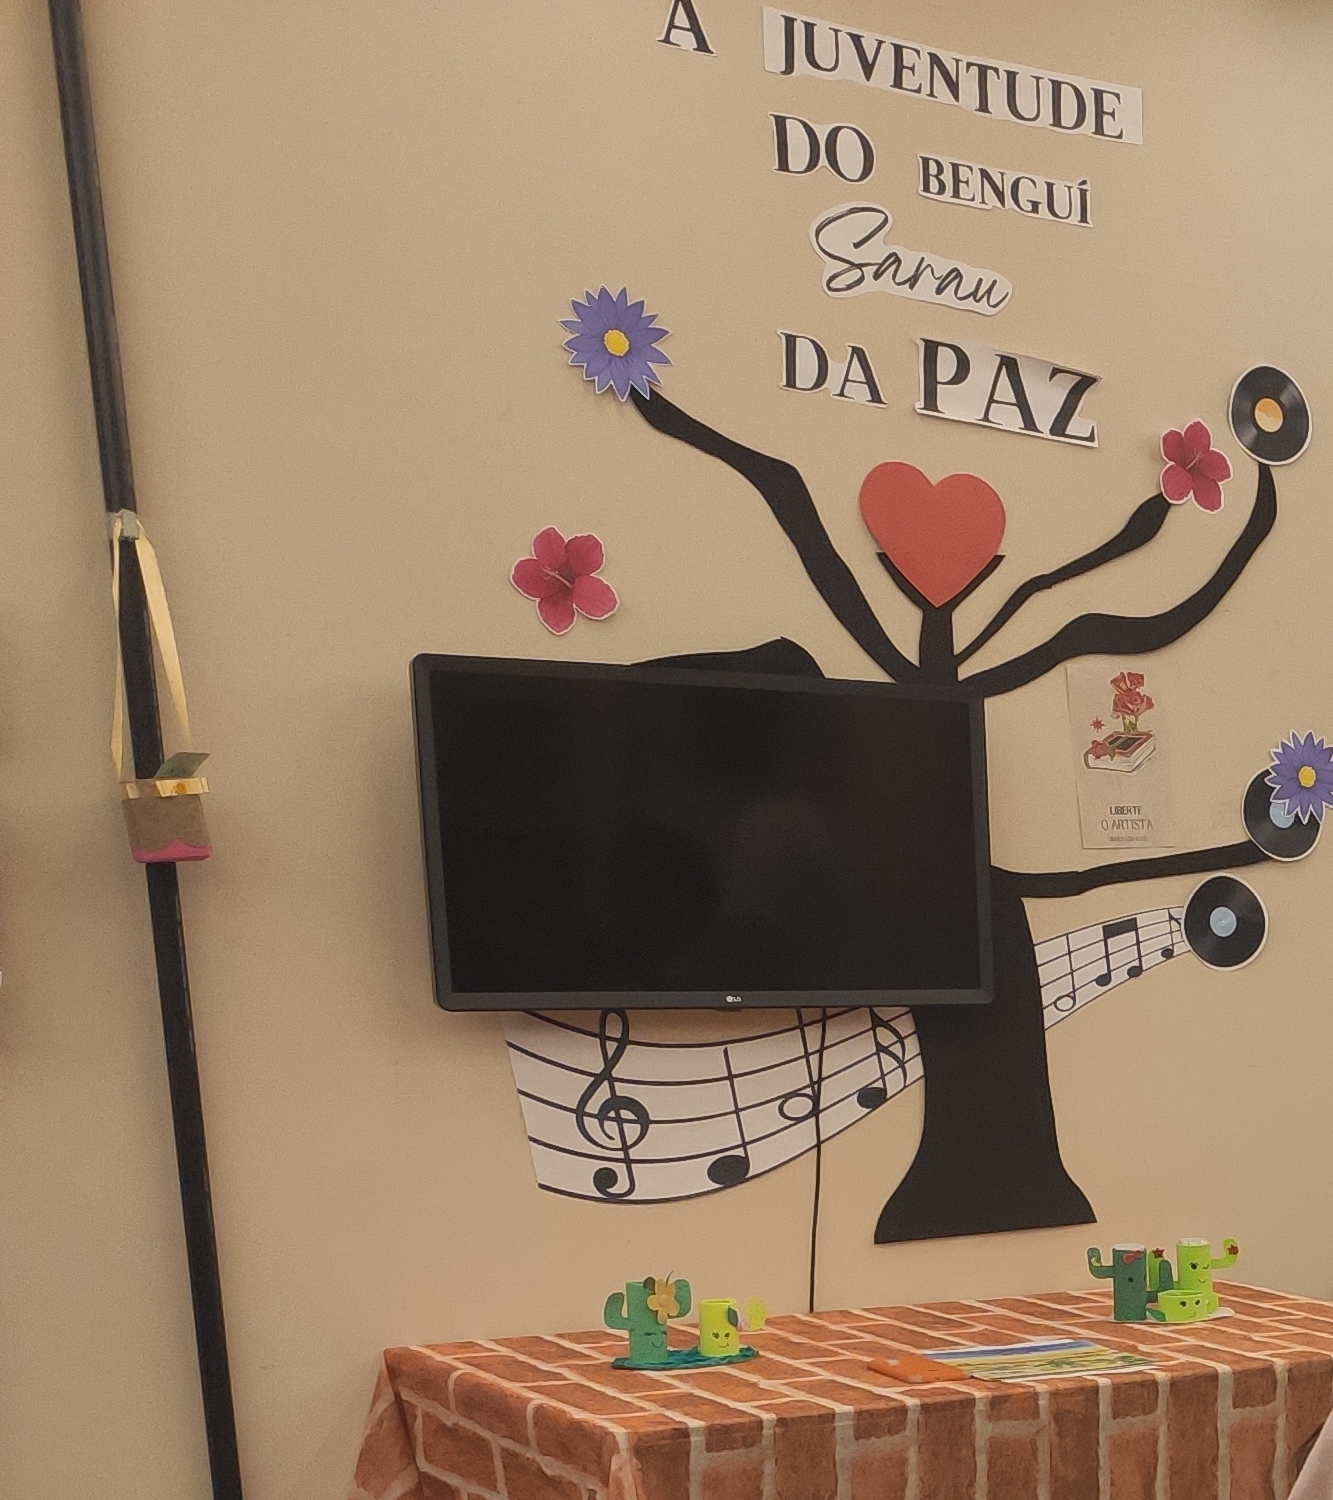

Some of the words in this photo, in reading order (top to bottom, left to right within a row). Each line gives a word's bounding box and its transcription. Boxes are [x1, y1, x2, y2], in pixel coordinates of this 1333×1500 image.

[657, 0, 717, 55] A
[780, 14, 1124, 140] JUVENTUDE
[769, 114, 875, 183] DO
[918, 155, 1091, 225] BENGUÍ
[814, 206, 1010, 310] Sarau
[780, 332, 888, 406] DA
[917, 337, 1101, 444] PAZ
